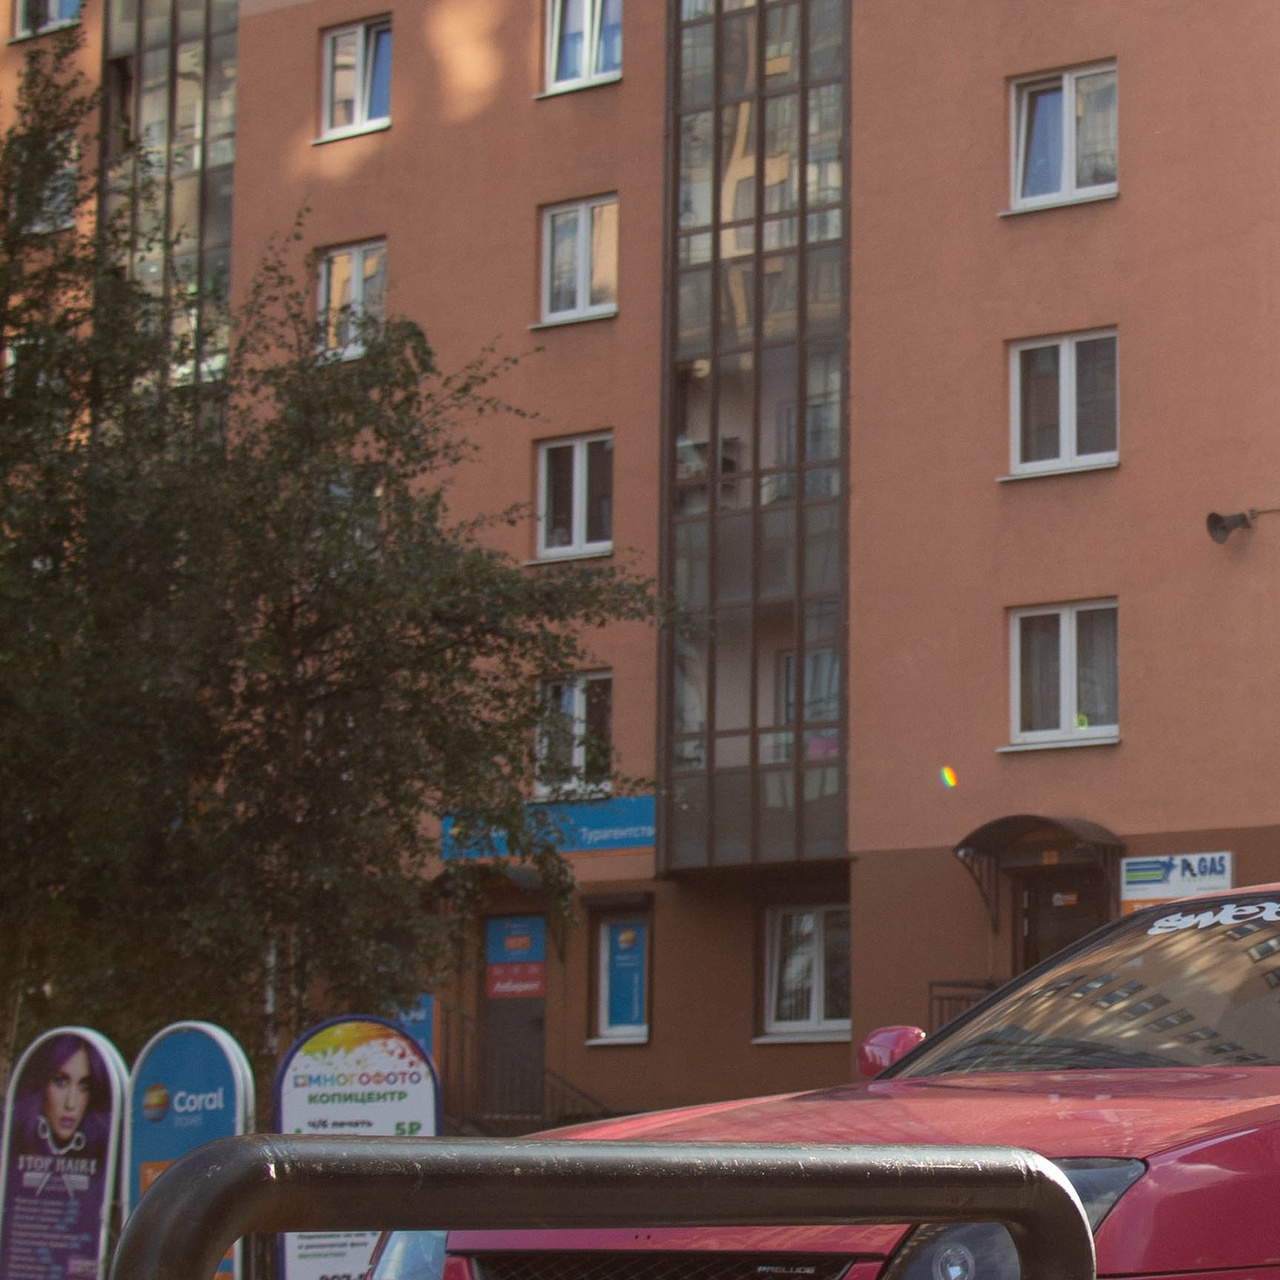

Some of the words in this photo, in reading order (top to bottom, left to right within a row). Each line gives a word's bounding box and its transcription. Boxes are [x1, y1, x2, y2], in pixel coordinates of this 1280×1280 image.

[308, 1071, 422, 1088] МНОГОФОТО
[173, 1086, 225, 1113] Coral
[308, 1091, 408, 1105] КОПИЦЕНТР
[757, 1265, 816, 1274] PRELUDE
